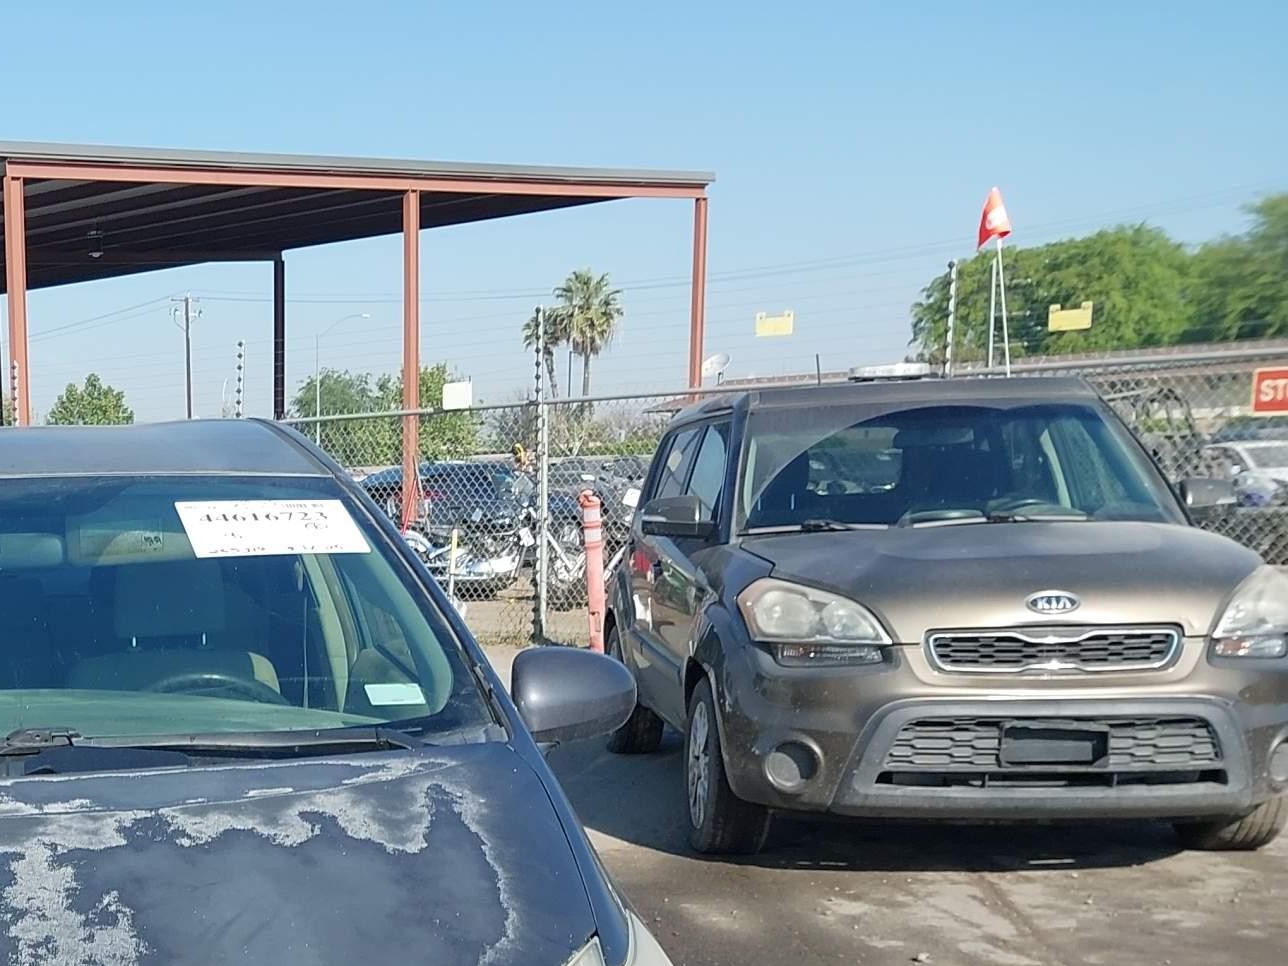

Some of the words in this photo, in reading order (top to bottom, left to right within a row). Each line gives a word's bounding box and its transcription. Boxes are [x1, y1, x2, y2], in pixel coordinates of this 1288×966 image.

[1260, 379, 1288, 402] ST
[199, 511, 328, 522] 44616723
[1037, 598, 1072, 610] KIA
